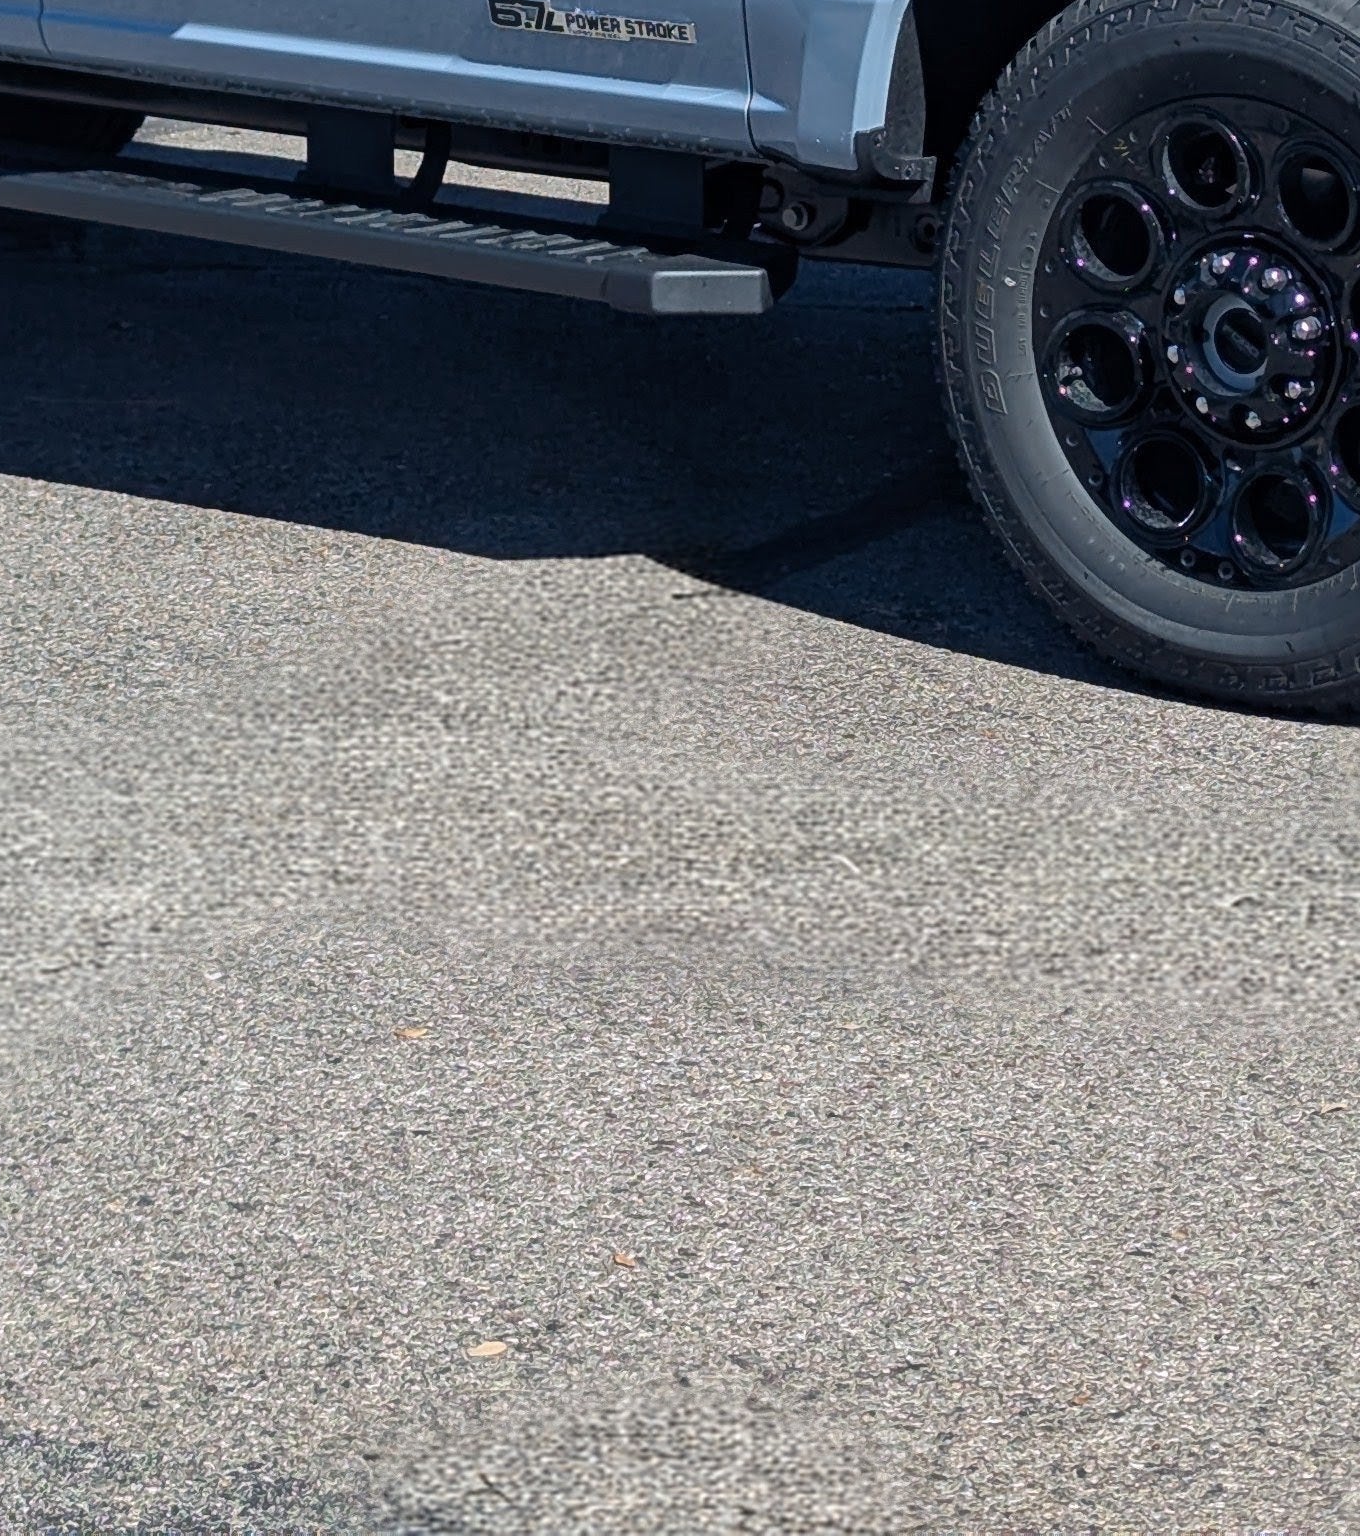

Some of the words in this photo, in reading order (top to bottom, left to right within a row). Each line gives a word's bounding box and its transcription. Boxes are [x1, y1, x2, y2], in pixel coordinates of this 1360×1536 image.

[565, 12, 622, 35] POWER
[624, 19, 689, 41] STROKE
[975, 154, 1029, 415] DUELER
